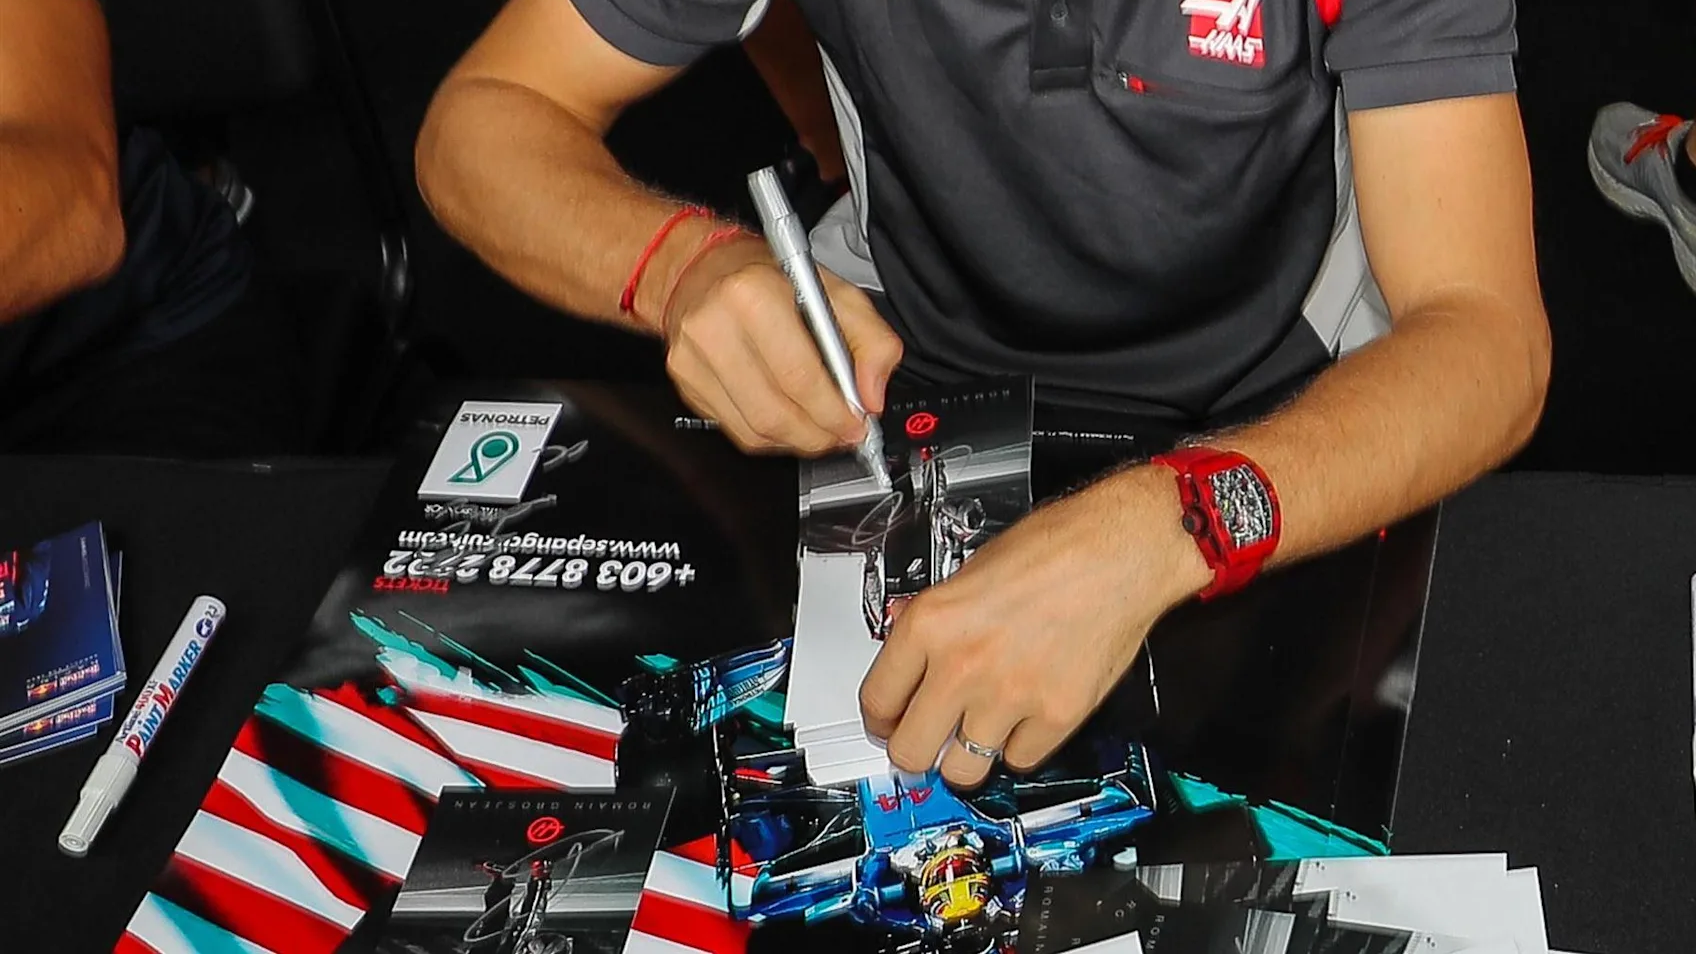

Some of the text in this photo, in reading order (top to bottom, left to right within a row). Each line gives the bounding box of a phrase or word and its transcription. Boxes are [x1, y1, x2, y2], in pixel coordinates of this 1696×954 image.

[1188, 29, 1263, 64] HAAS
[459, 411, 551, 428] PETRONAS
[488, 555, 588, 587] 8778
[596, 559, 696, 592] +603
[153, 639, 202, 711] MARKER
